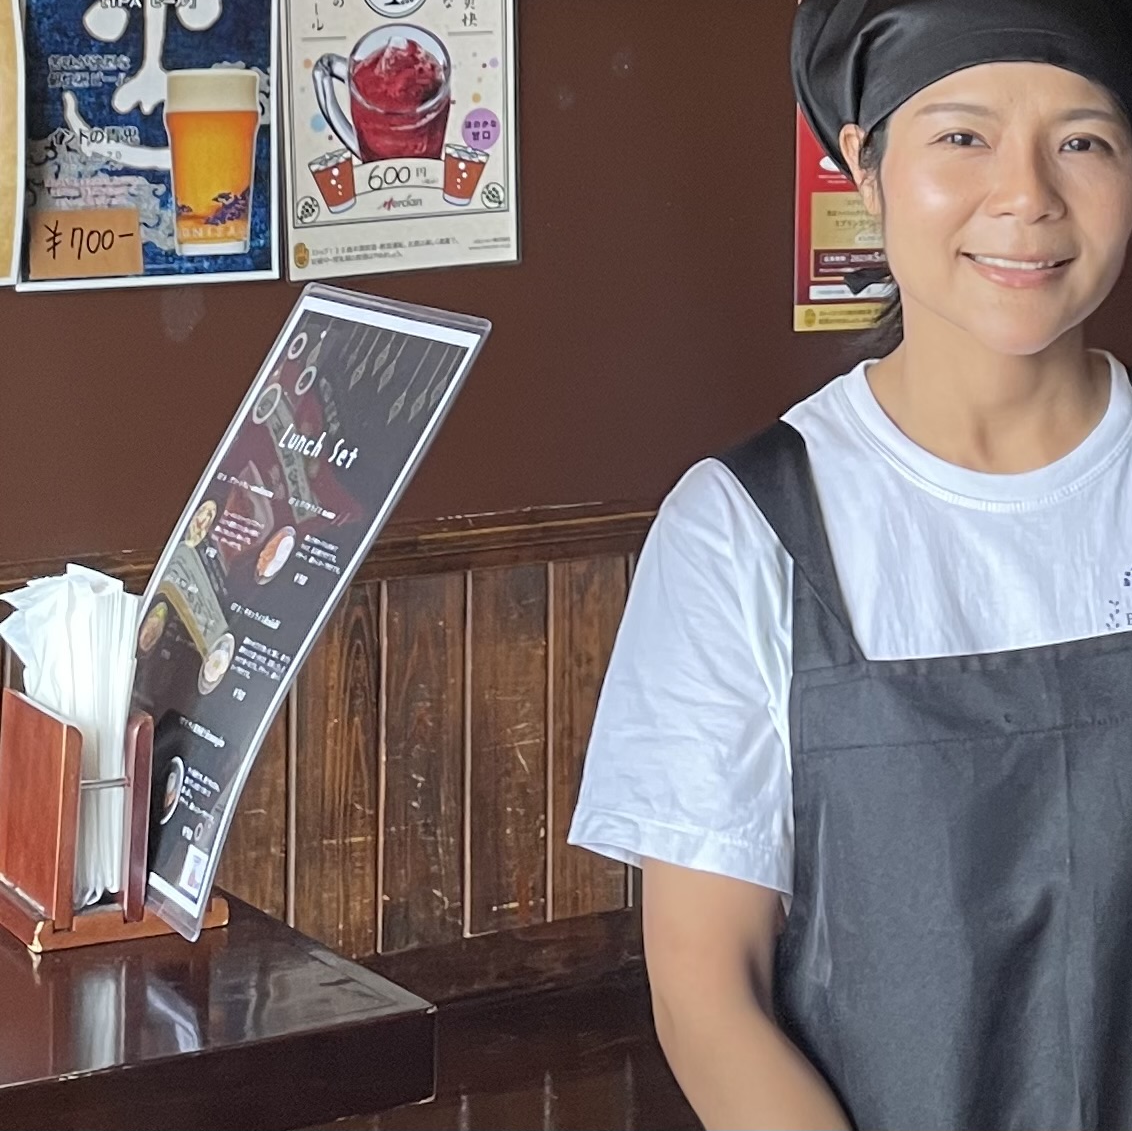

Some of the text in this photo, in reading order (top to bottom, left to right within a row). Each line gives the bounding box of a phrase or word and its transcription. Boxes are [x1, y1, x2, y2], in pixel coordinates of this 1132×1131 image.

[368, 164, 411, 191] 600
[278, 423, 359, 470] Lunch Set
